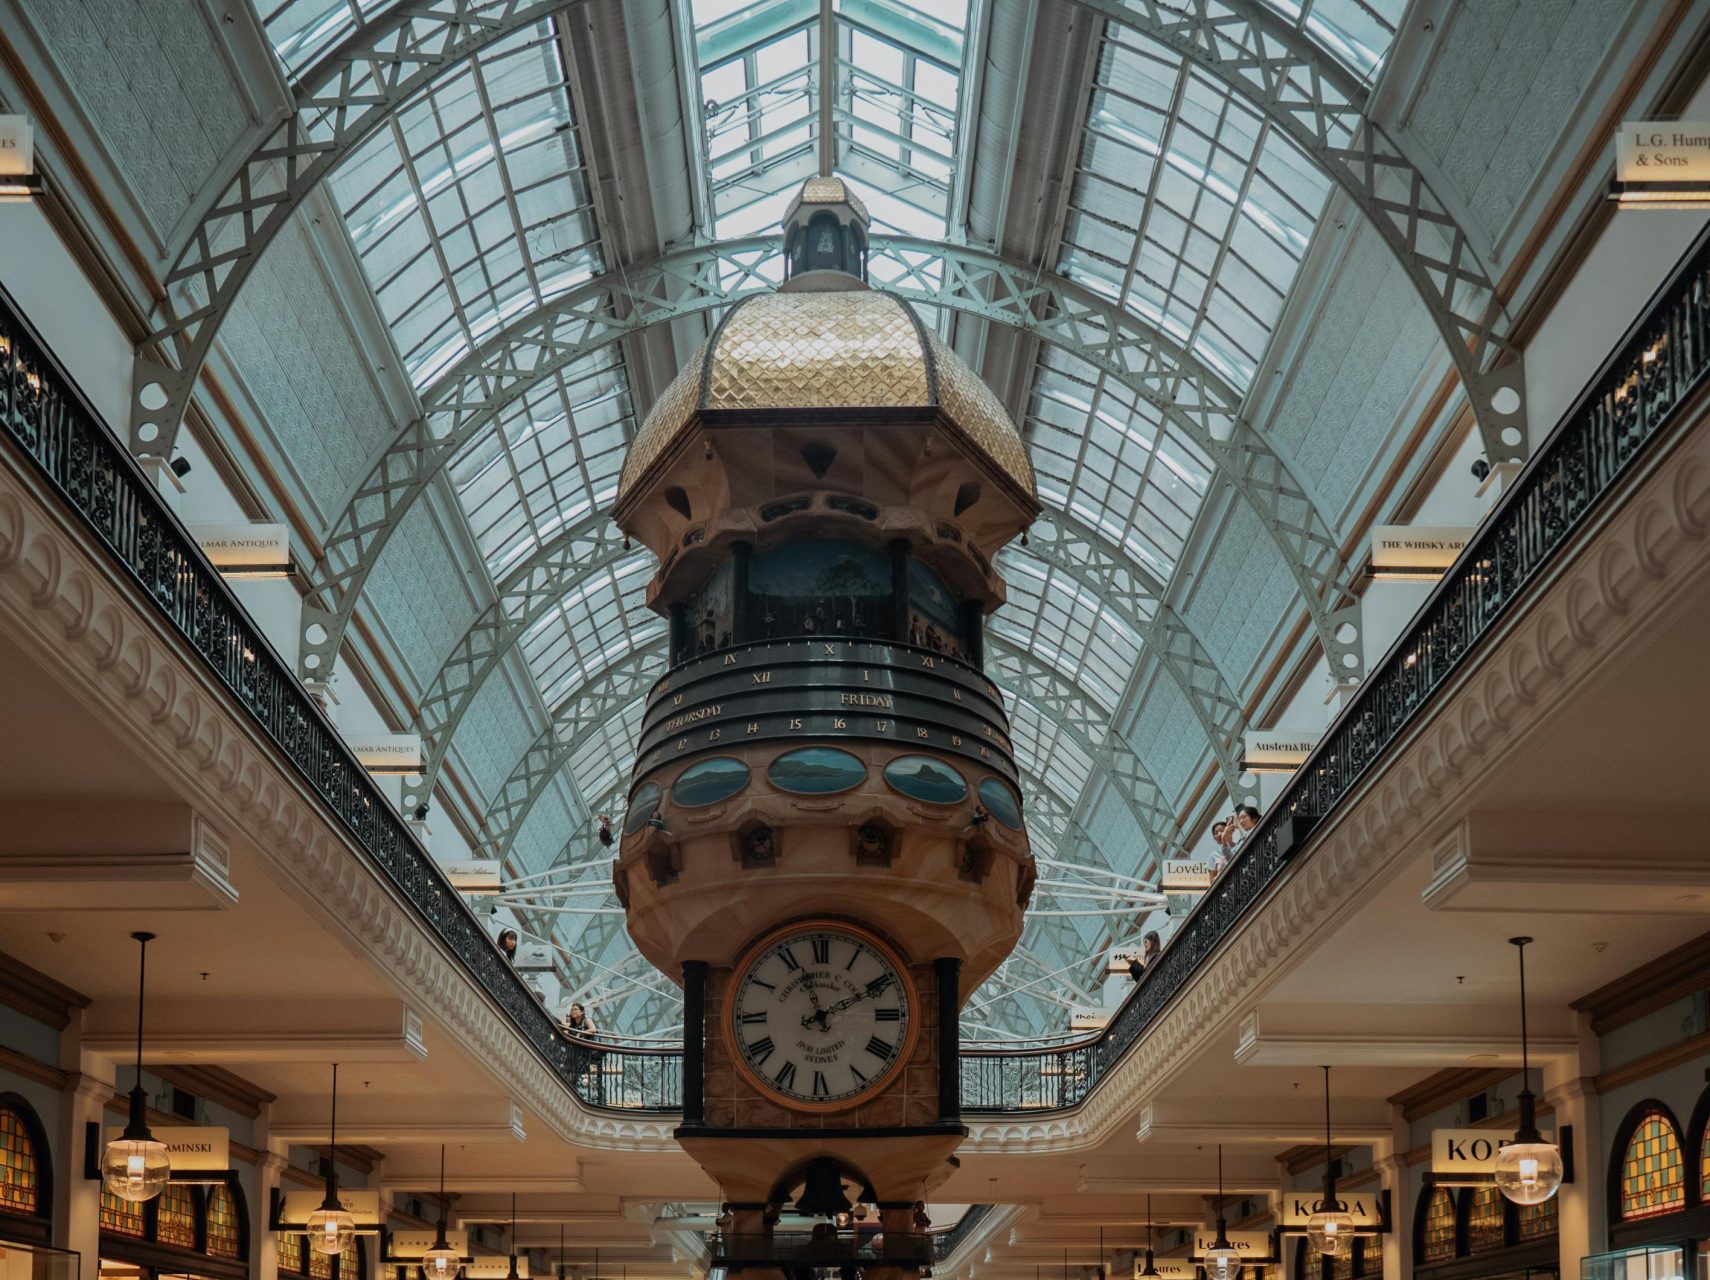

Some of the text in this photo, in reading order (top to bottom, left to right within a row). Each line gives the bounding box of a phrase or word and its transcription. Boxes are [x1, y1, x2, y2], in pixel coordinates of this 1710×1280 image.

[1636, 133, 1668, 147] L.G.
[1636, 153, 1688, 166] & Sons
[231, 540, 280, 550] ANTIQUES
[1382, 540, 1402, 549] THE
[1406, 540, 1444, 550] WHISKY
[724, 654, 736, 665] IX
[825, 643, 835, 655] X
[921, 655, 935, 669] XI
[753, 672, 771, 685] XII
[863, 671, 869, 682] I
[666, 704, 725, 732] THURSDAY
[840, 693, 891, 708] FRIDAY
[677, 738, 687, 751] 12
[709, 729, 720, 742] 13
[747, 721, 759, 734] 14
[789, 718, 802, 730] 15
[834, 718, 846, 730] 16
[876, 720, 888, 733] 17
[917, 726, 928, 739] 18
[951, 734, 962, 747] 19
[377, 744, 414, 754] ANTIQUES
[810, 939, 832, 965] XII
[845, 949, 862, 972] I
[749, 974, 776, 995] X
[742, 1009, 768, 1026] IX
[875, 1008, 901, 1023] III
[747, 1035, 776, 1067] VIII
[804, 1054, 838, 1065] SYDNEY
[775, 1059, 798, 1091] VII
[811, 1070, 831, 1097] VI
[165, 1143, 212, 1153] AMINSKI
